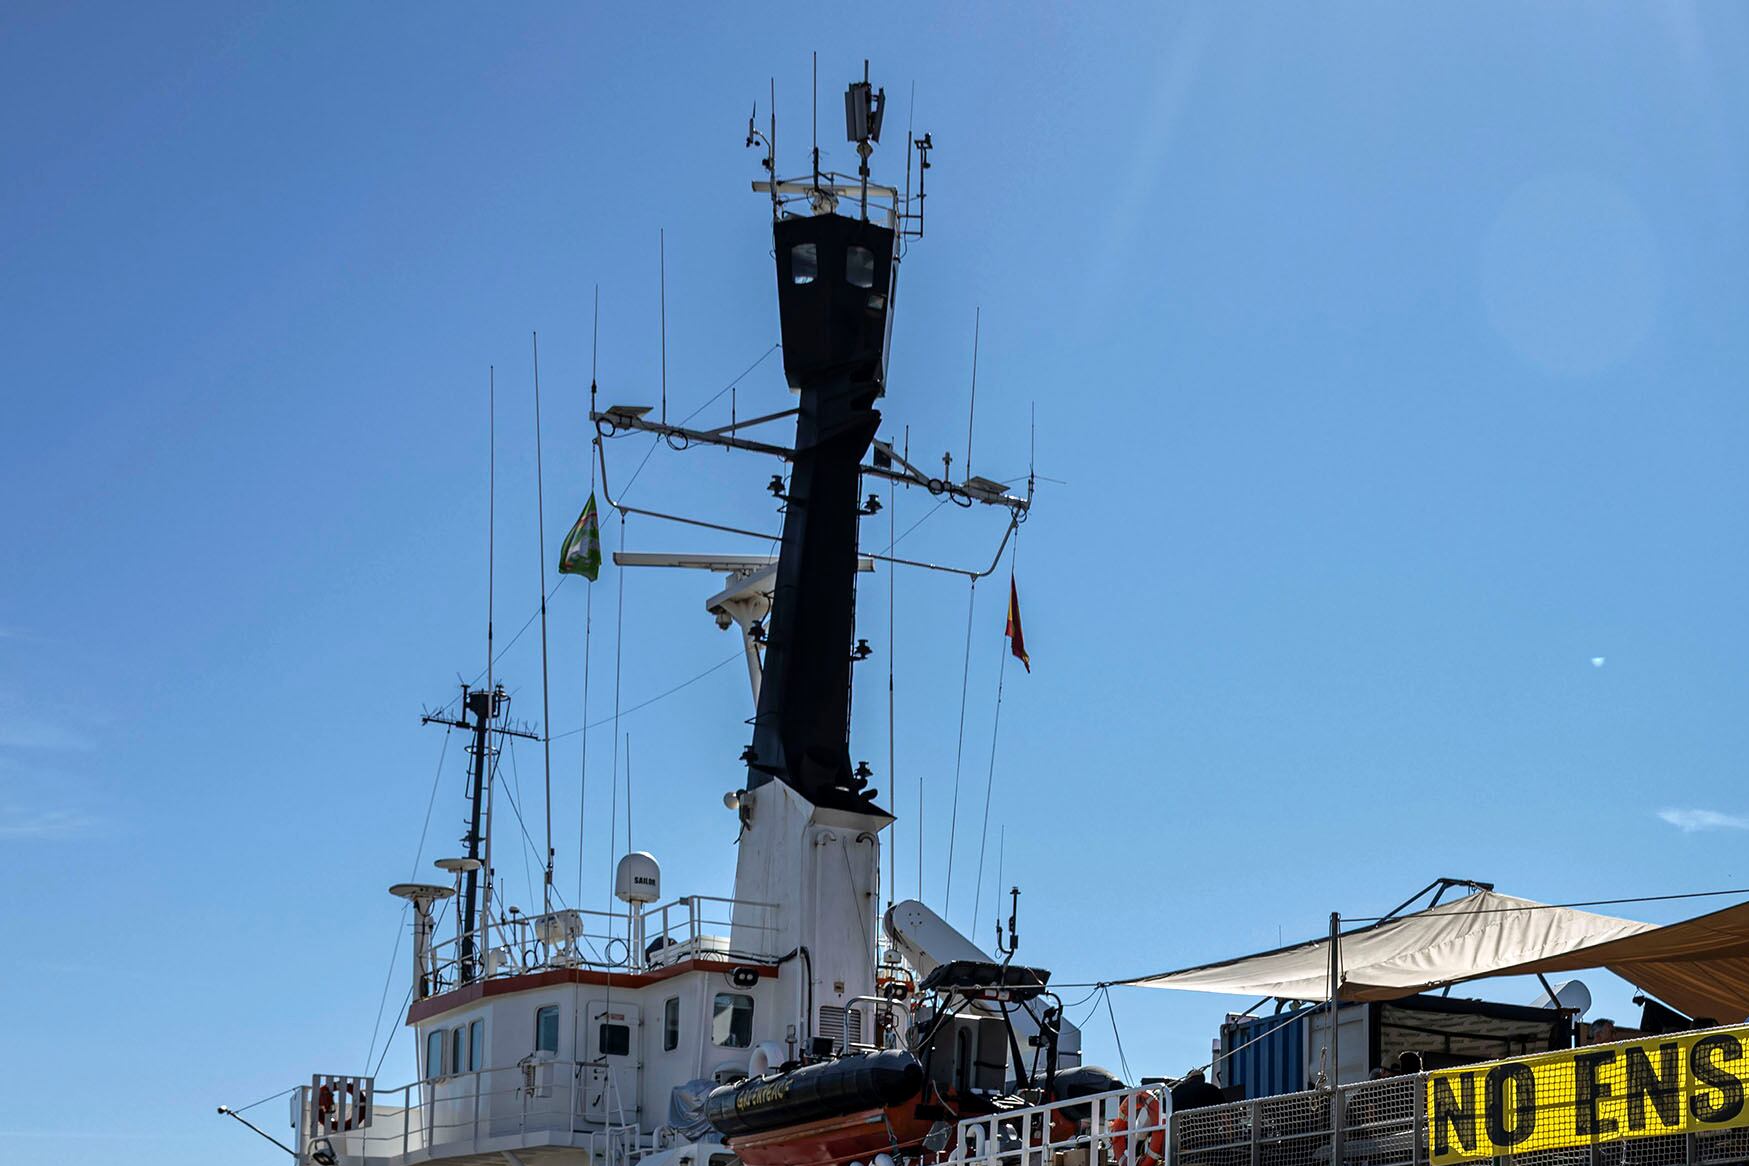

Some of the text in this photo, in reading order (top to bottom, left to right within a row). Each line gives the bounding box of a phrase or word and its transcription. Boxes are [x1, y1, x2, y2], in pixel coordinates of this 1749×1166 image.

[634, 876, 656, 886] SAILOR
[1433, 1062, 1536, 1156] NO
[1573, 1034, 1745, 1136] ENS
